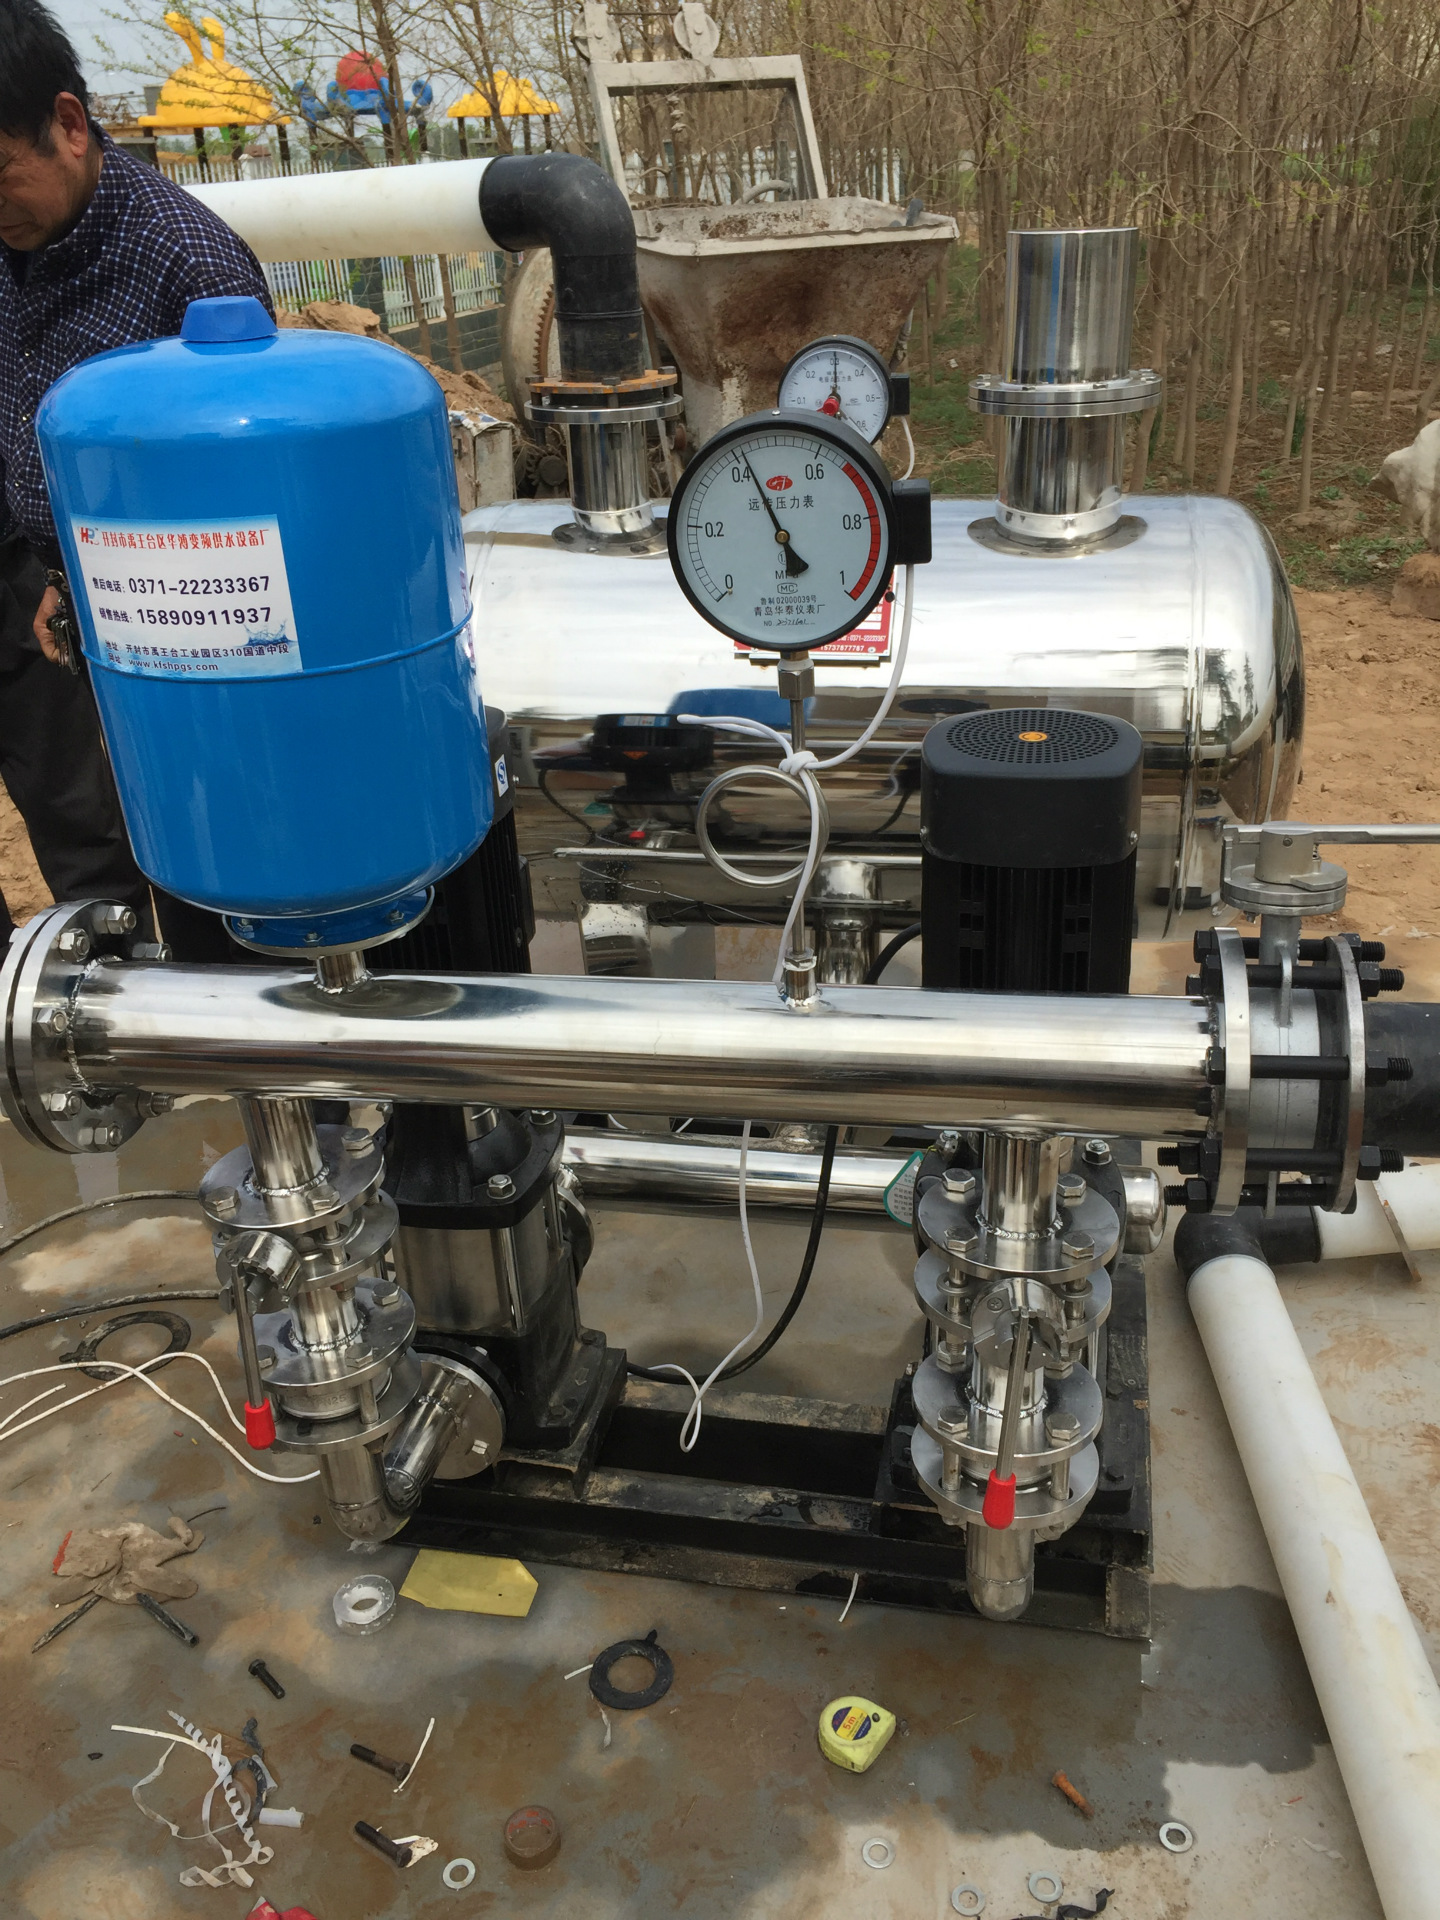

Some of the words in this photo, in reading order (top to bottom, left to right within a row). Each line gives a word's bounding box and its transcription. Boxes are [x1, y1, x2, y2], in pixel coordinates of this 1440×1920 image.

[805, 370, 815, 379] 0.2
[855, 369, 865, 377] 0.4
[866, 394, 876, 402] 0.5
[731, 466, 751, 483] 0.4
[805, 463, 825, 480] 0.6
[748, 494, 814, 511] 远传压力表
[705, 522, 725, 538] 0.2
[842, 514, 862, 531] 0.8
[725, 574, 734, 589] 0
[839, 570, 846, 585] 1
[128, 576, 270, 595] 0371-22233367
[137, 607, 271, 626] 15890911937
[754, 604, 826, 617] 青岛华泰仪表厂
[128, 657, 219, 672] www.kfshpgs.com
[843, 1716, 856, 1730] 5m
